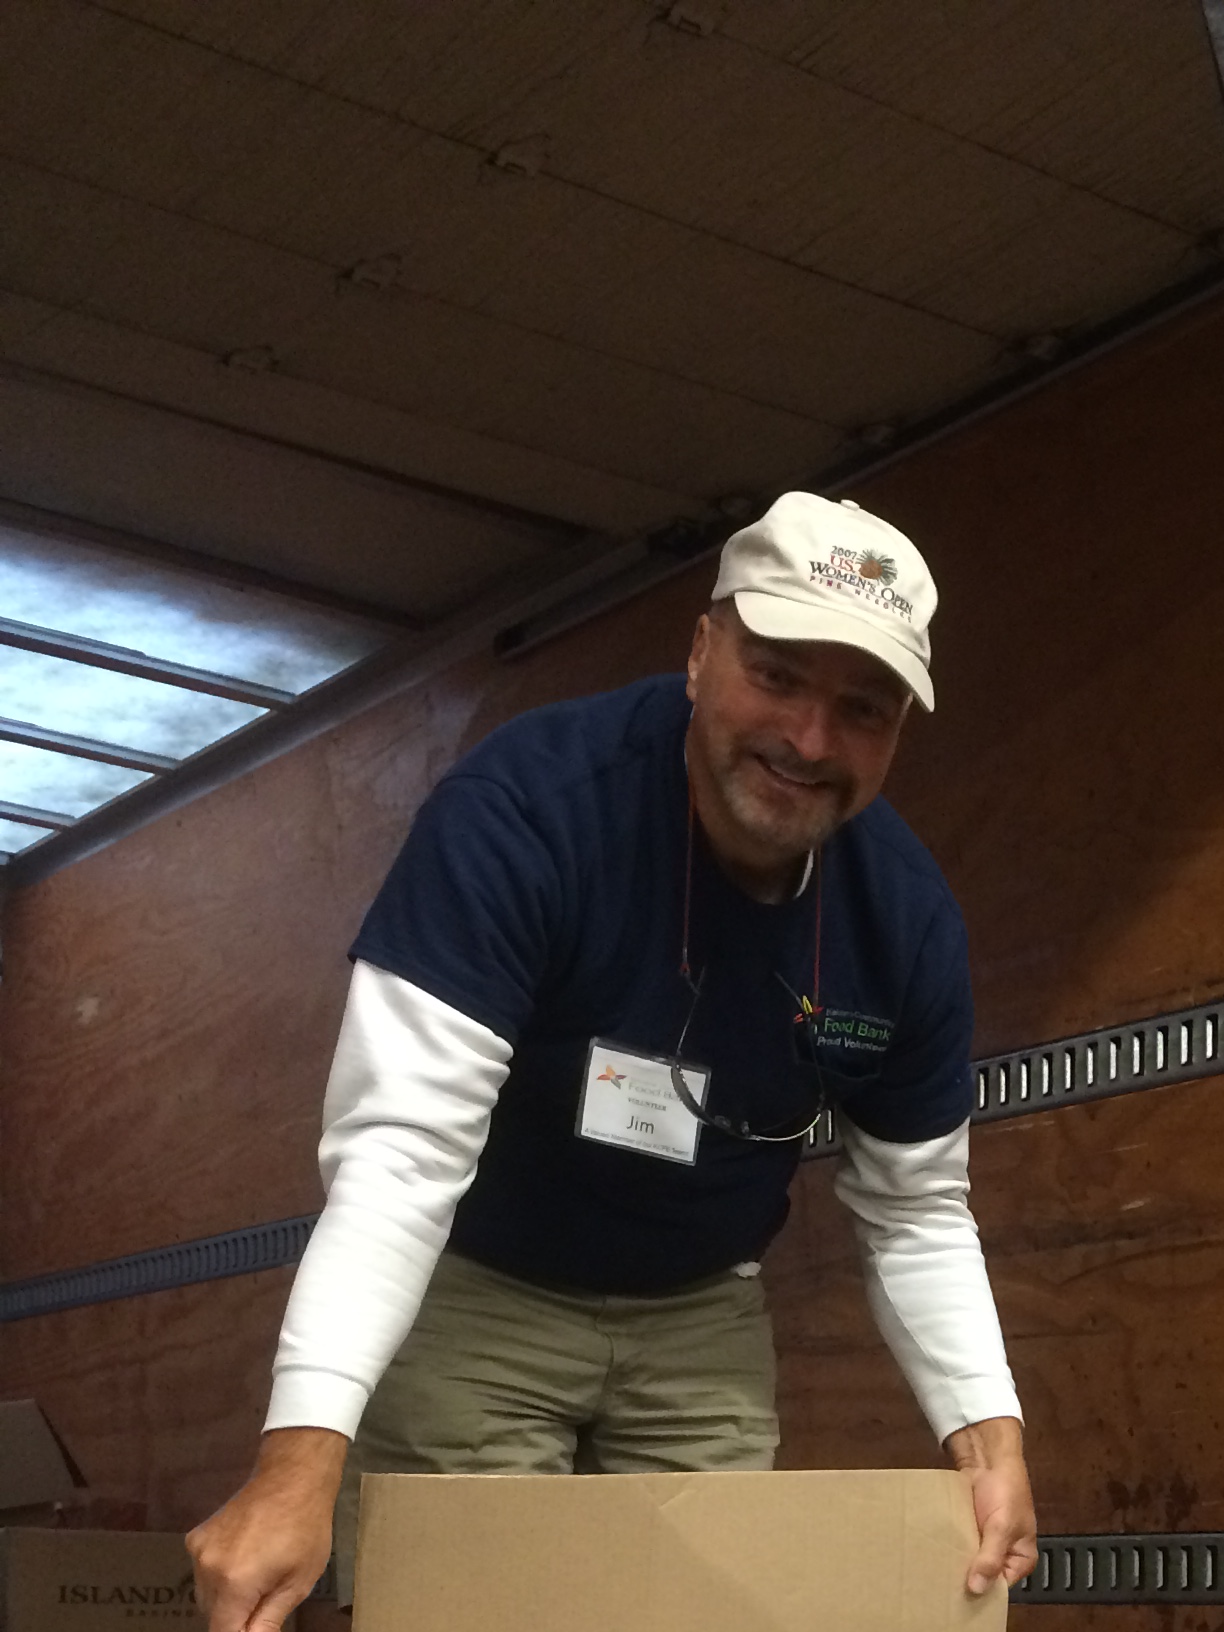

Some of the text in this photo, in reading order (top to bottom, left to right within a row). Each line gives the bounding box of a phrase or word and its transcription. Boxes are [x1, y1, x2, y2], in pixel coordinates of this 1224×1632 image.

[831, 546, 857, 560] 2007
[824, 1018, 891, 1041] Food Bank
[626, 1115, 655, 1135] Jim
[58, 1584, 175, 1605] ISLAND
